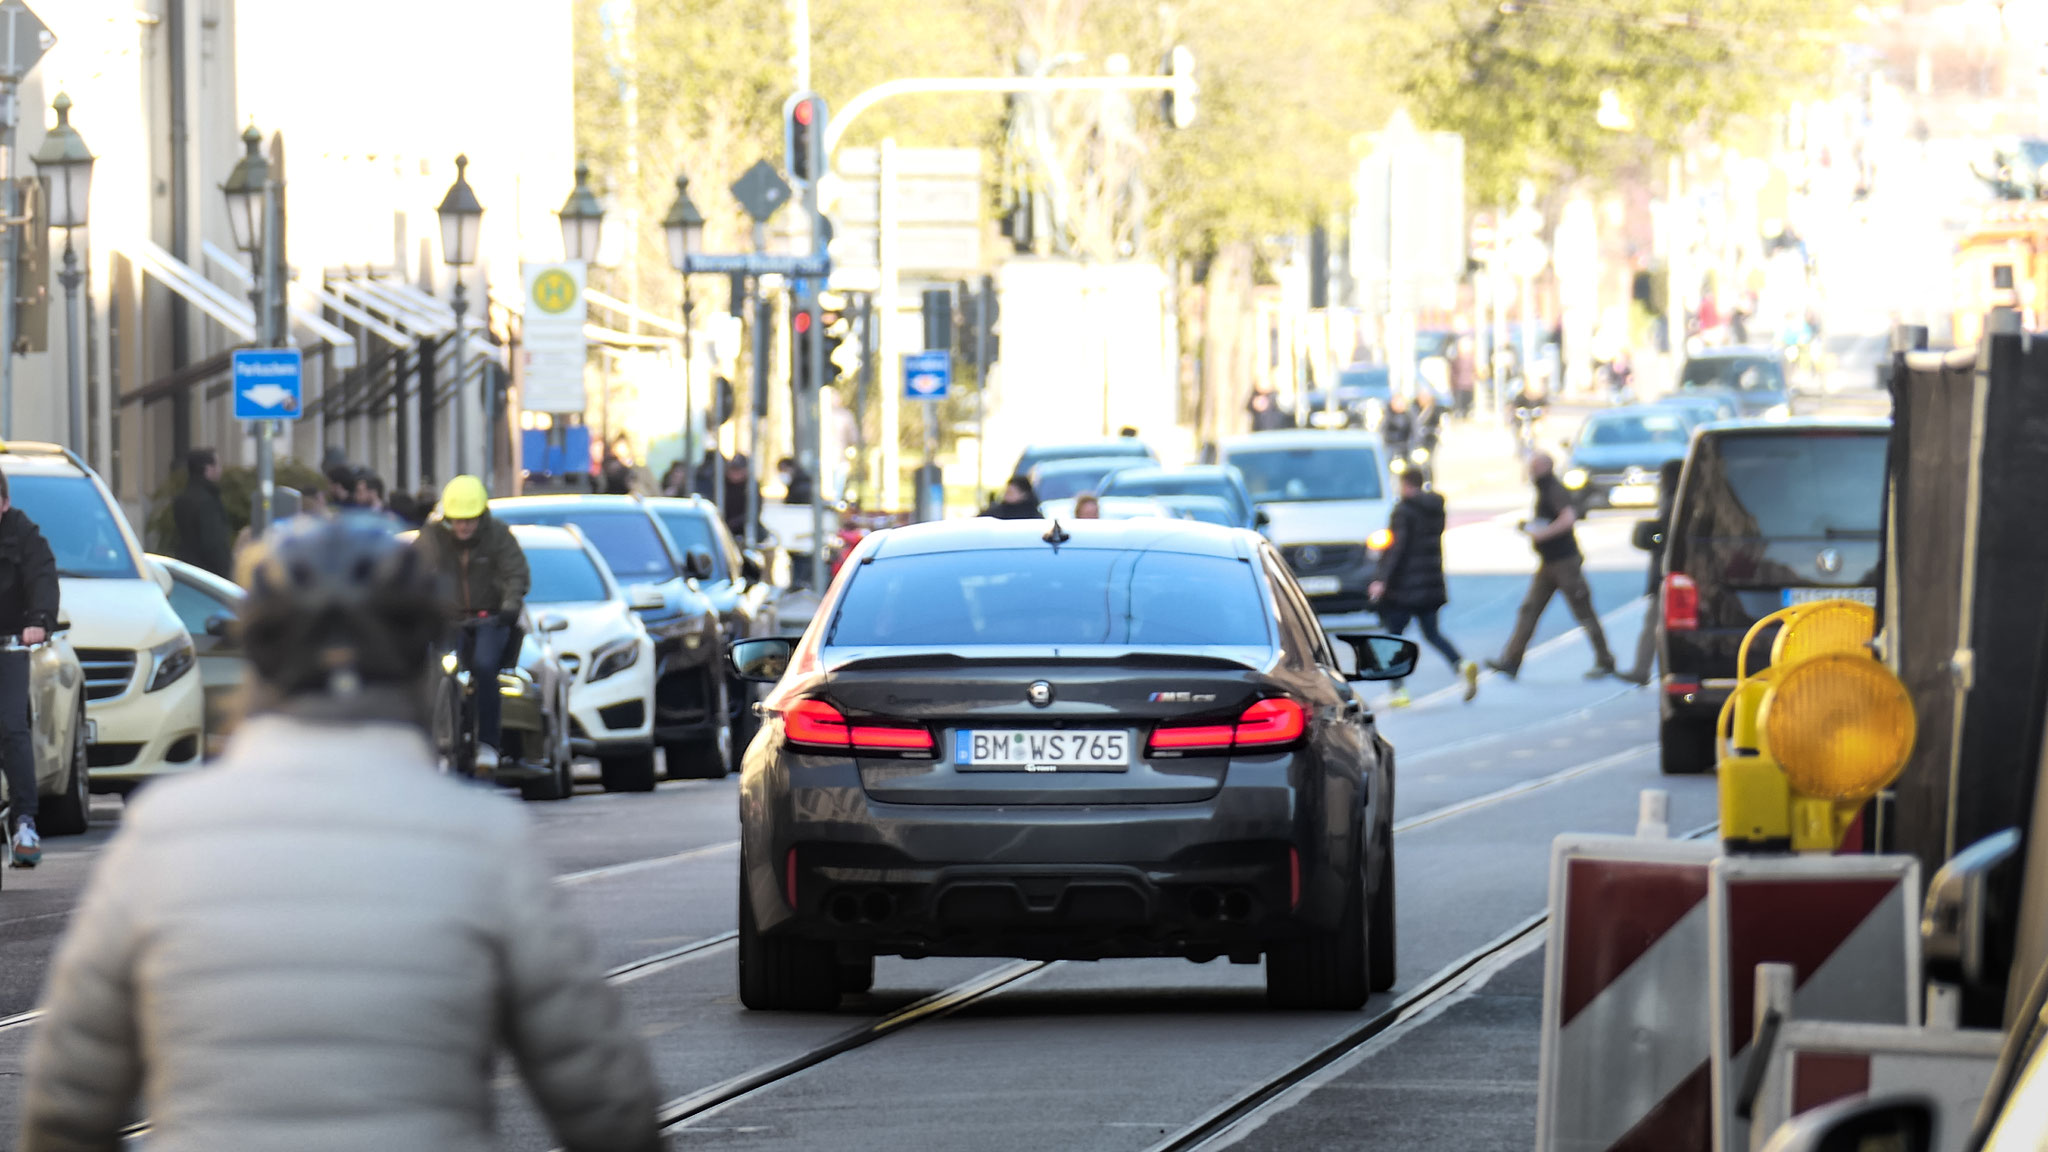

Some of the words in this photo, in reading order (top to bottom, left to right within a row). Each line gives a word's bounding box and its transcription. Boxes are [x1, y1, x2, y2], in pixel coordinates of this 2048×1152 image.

[974, 735, 1009, 760] BM
[1030, 735, 1065, 760] WS
[1072, 735, 1123, 760] 765
